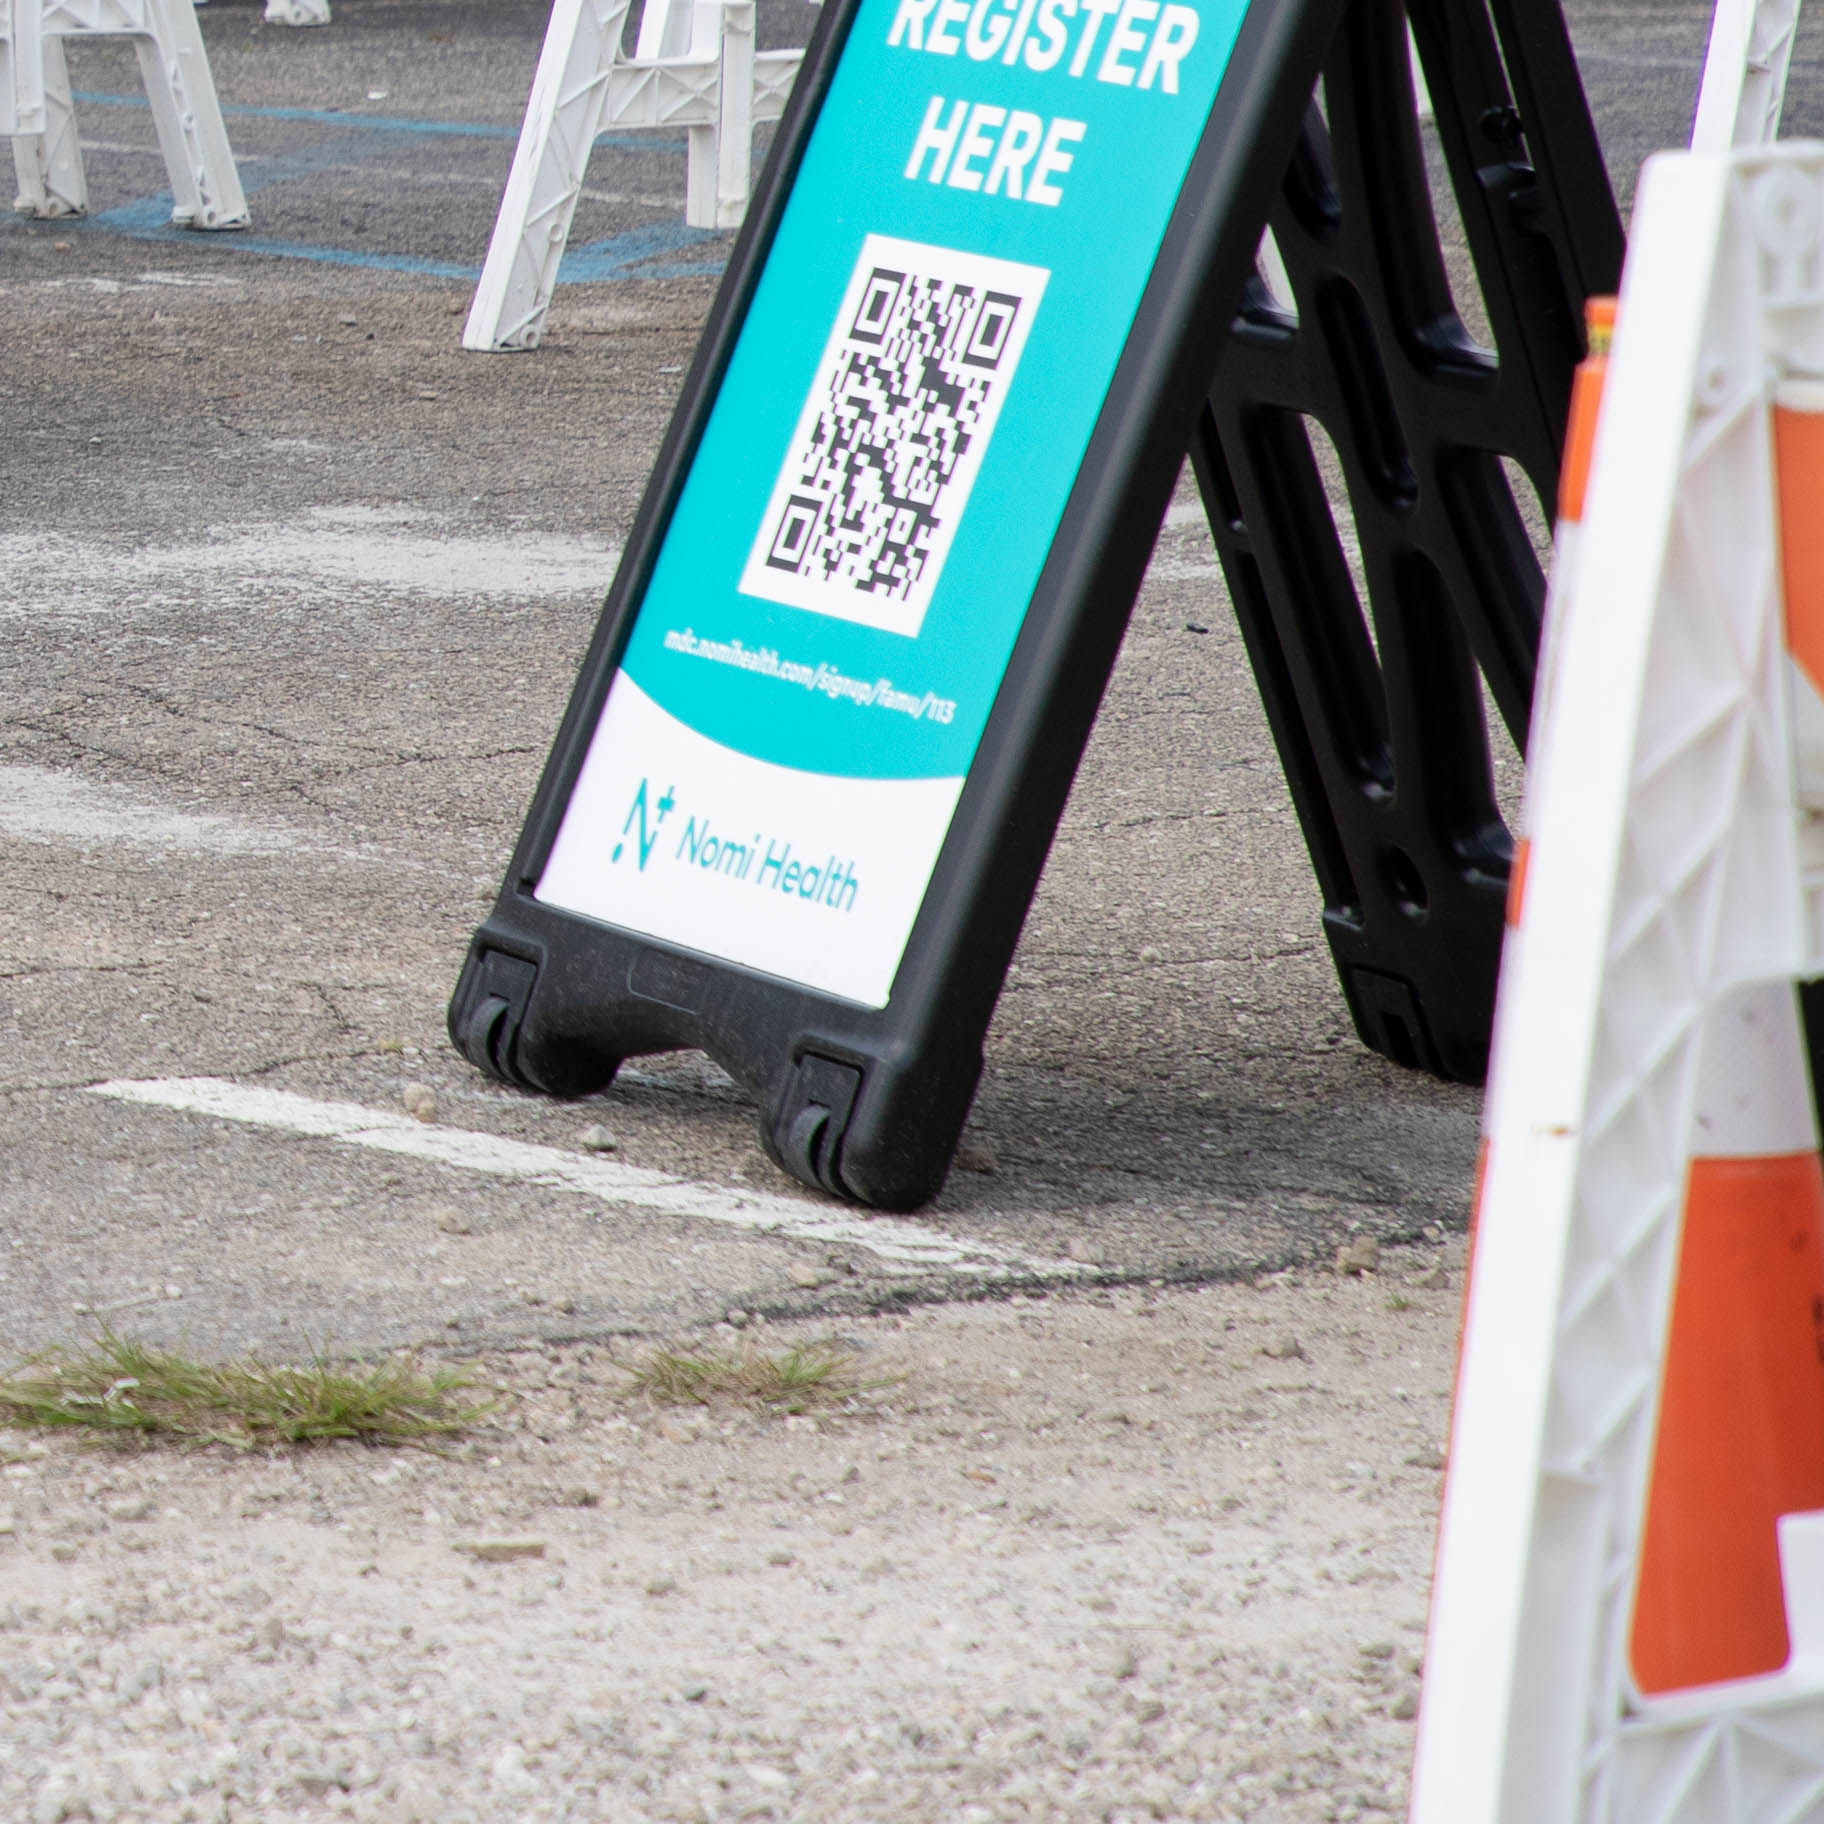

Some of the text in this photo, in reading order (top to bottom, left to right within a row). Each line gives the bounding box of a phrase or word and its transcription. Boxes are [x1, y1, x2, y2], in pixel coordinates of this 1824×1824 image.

[903, 95, 1087, 207] HERE
[676, 815, 859, 912] Nomi Health
